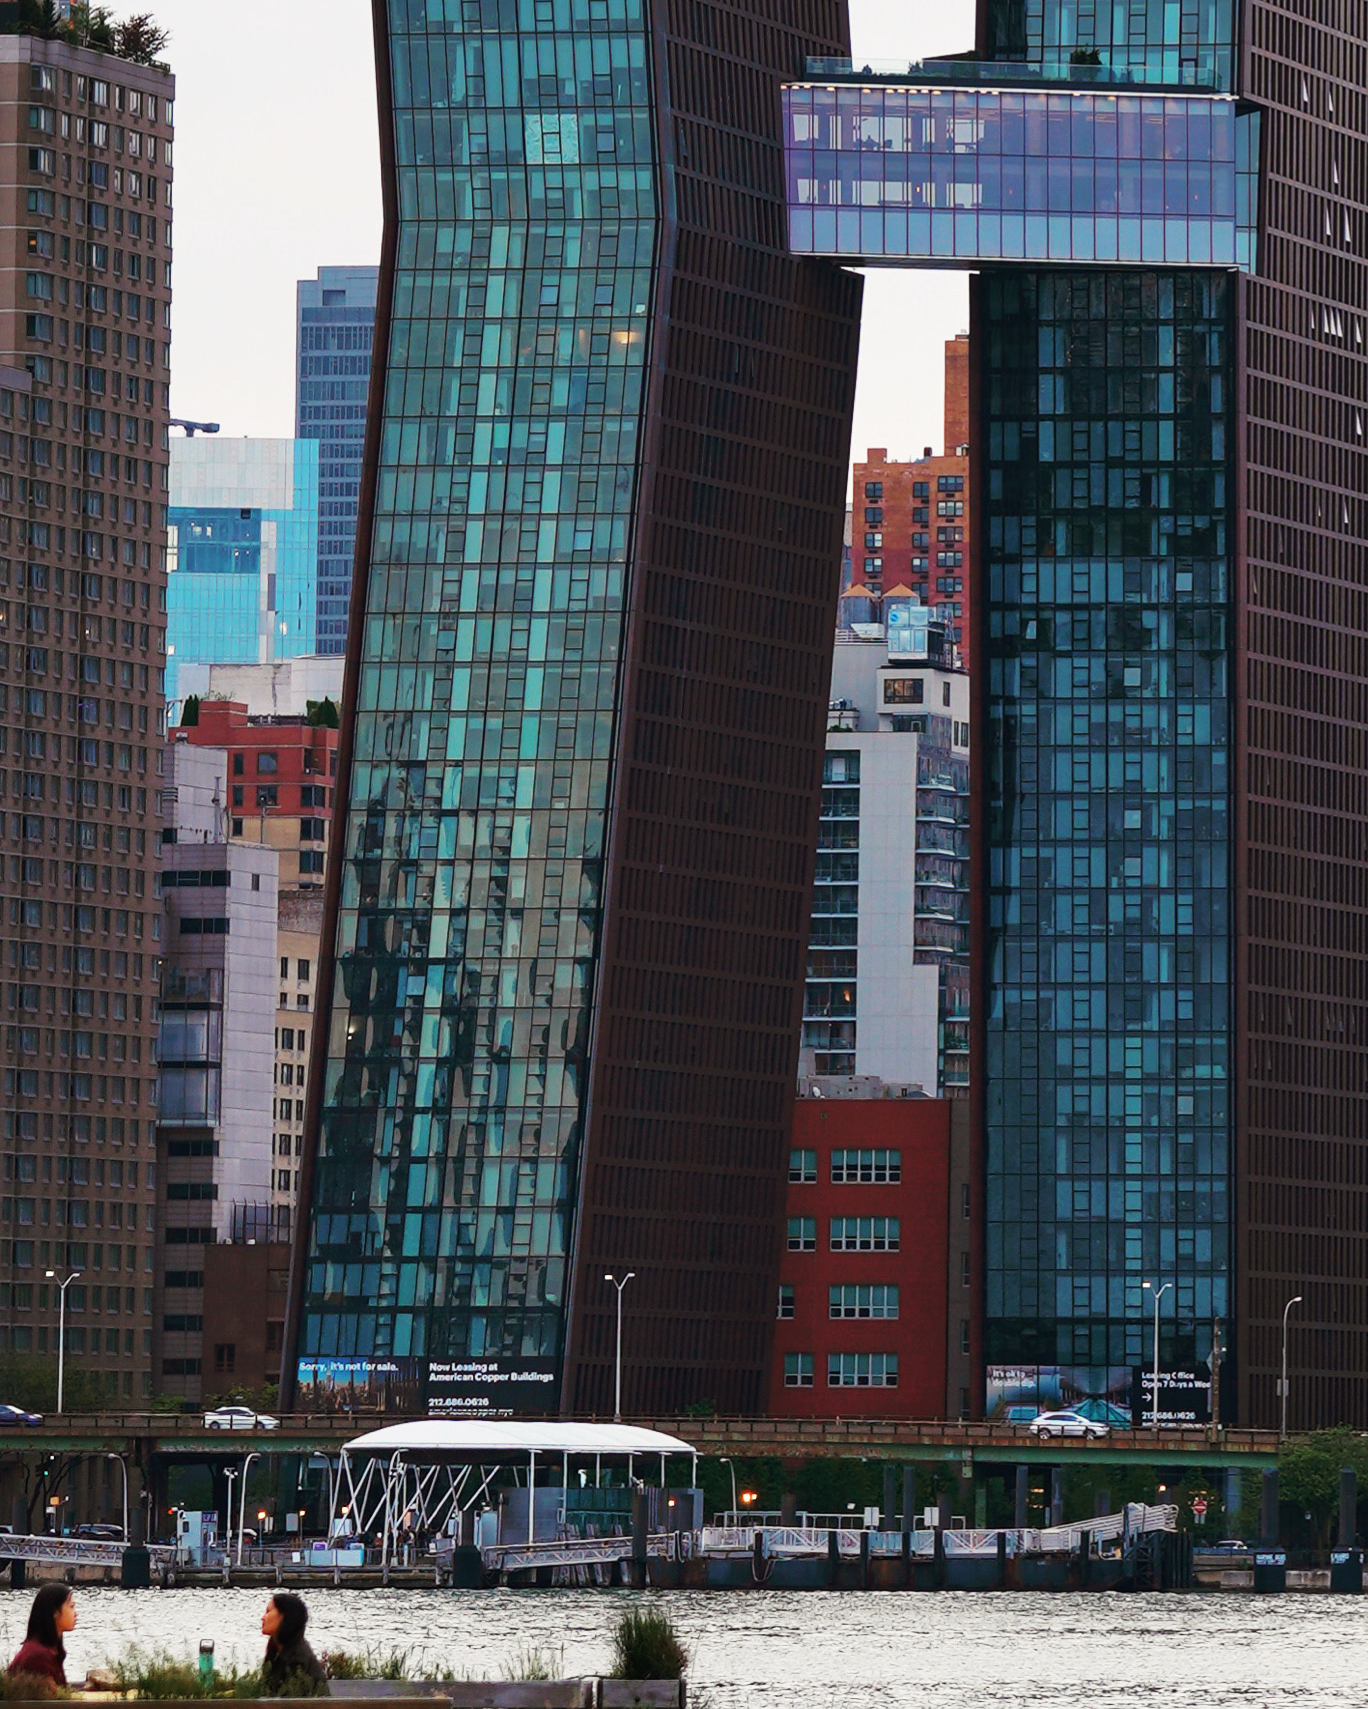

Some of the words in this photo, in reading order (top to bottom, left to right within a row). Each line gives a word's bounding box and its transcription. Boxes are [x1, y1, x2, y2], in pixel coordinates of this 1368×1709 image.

[299, 1362, 327, 1372] Sorry,
[330, 1361, 344, 1371] it's
[345, 1361, 360, 1371] not
[362, 1361, 376, 1371] for
[377, 1361, 399, 1371] sale.
[429, 1362, 450, 1371] Now
[451, 1362, 487, 1373] Leasing
[488, 1362, 498, 1371] at
[429, 1372, 474, 1381] American
[475, 1372, 509, 1382] Copper
[510, 1372, 554, 1382] Buildings
[1163, 1380, 1169, 1388] 7
[428, 1398, 489, 1406] 212.686.0626
